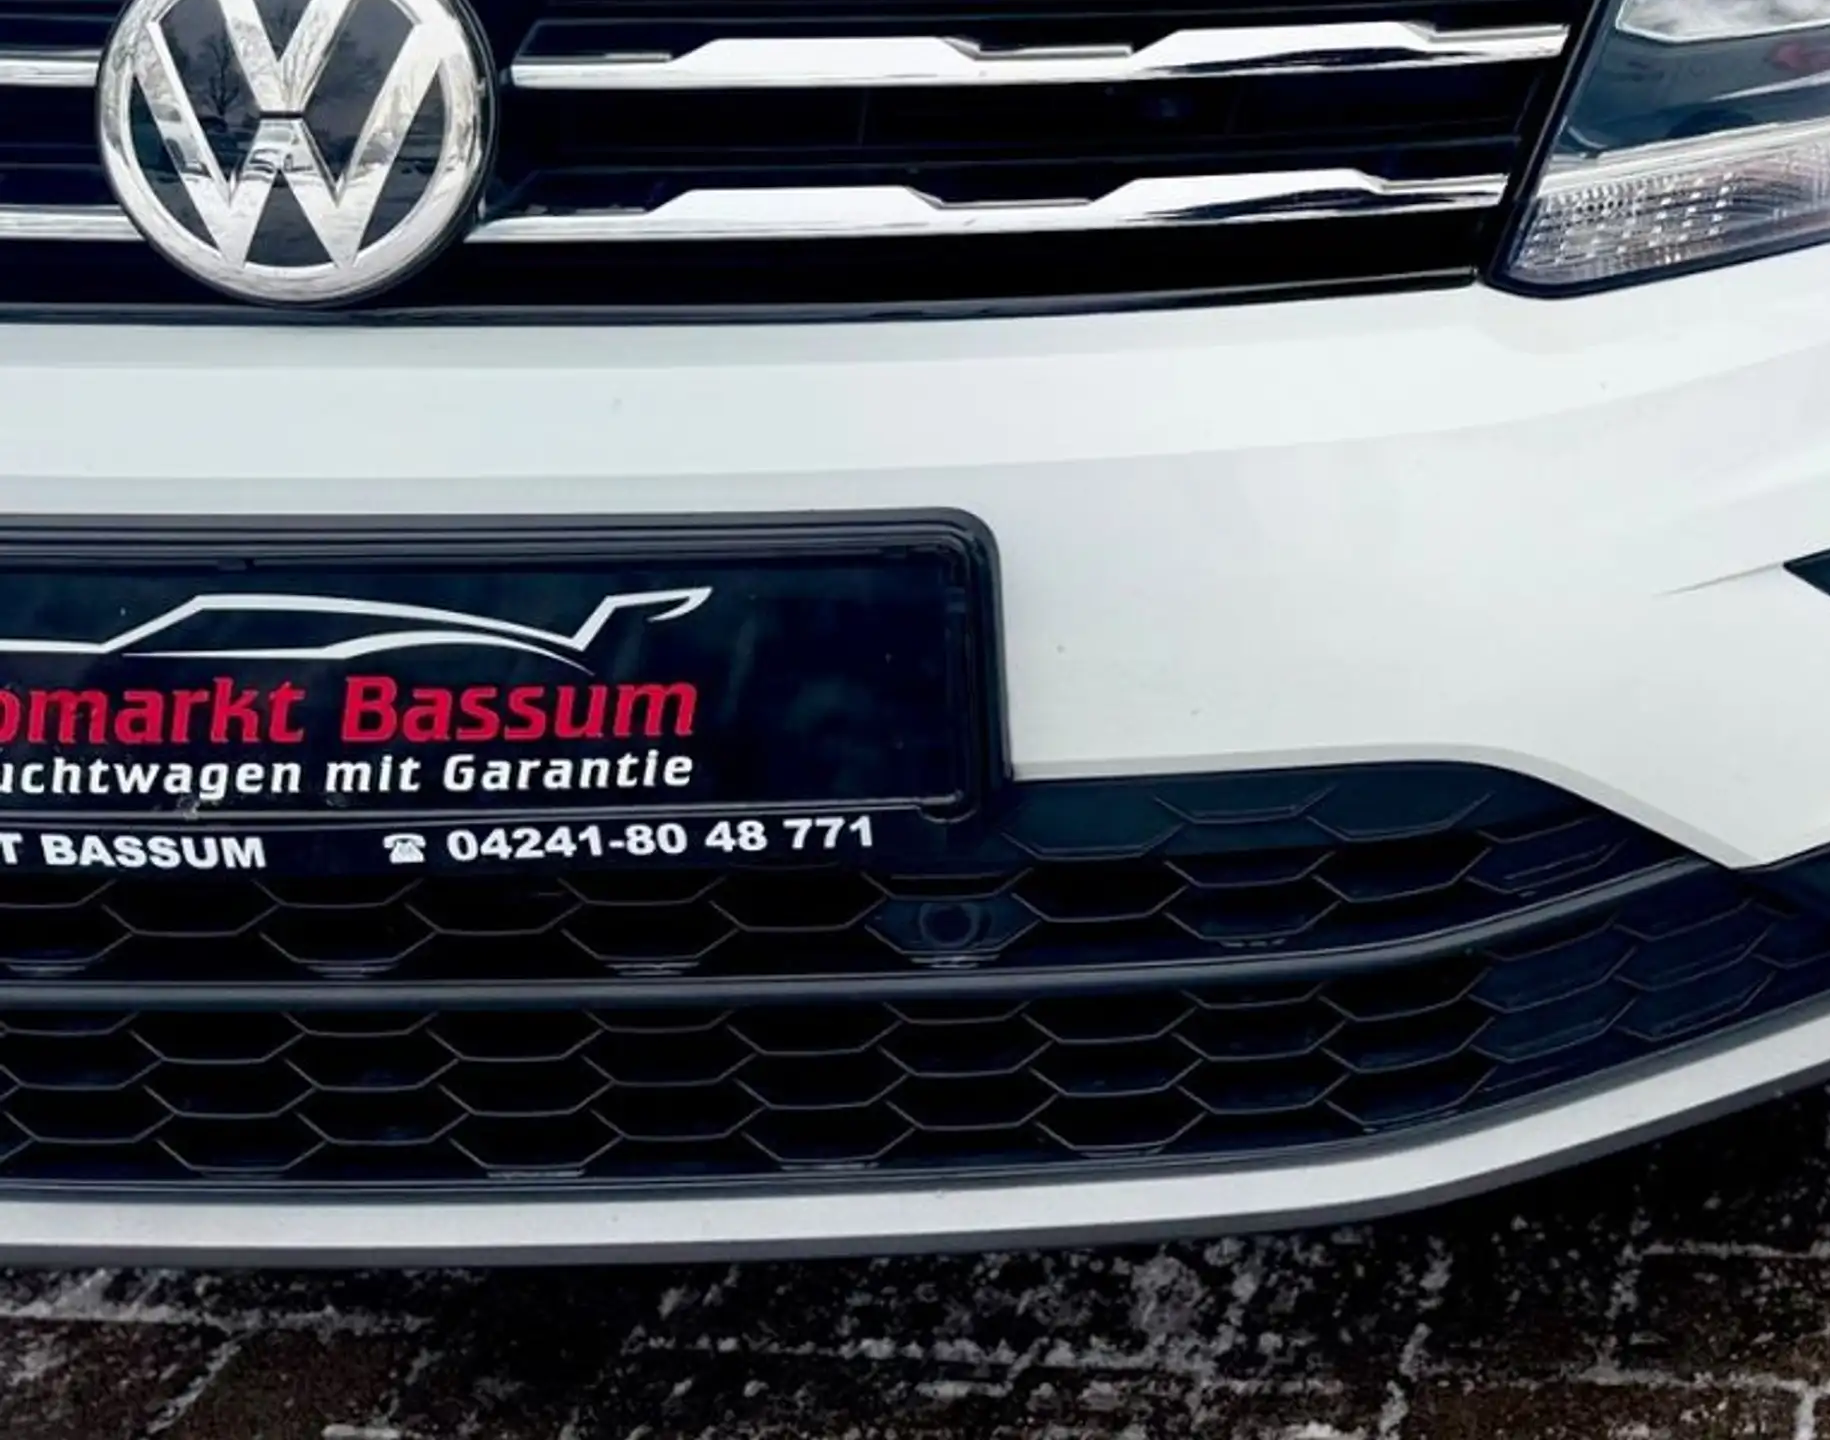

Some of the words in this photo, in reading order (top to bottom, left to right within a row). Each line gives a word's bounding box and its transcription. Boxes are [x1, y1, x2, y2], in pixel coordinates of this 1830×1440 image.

[341, 675, 697, 743] Bassum
[325, 755, 421, 792] mit
[443, 749, 693, 792] Garantie
[41, 834, 266, 869] BASSUM
[447, 823, 687, 861] 04241-80
[705, 820, 767, 852] 48
[783, 815, 873, 849] 771
